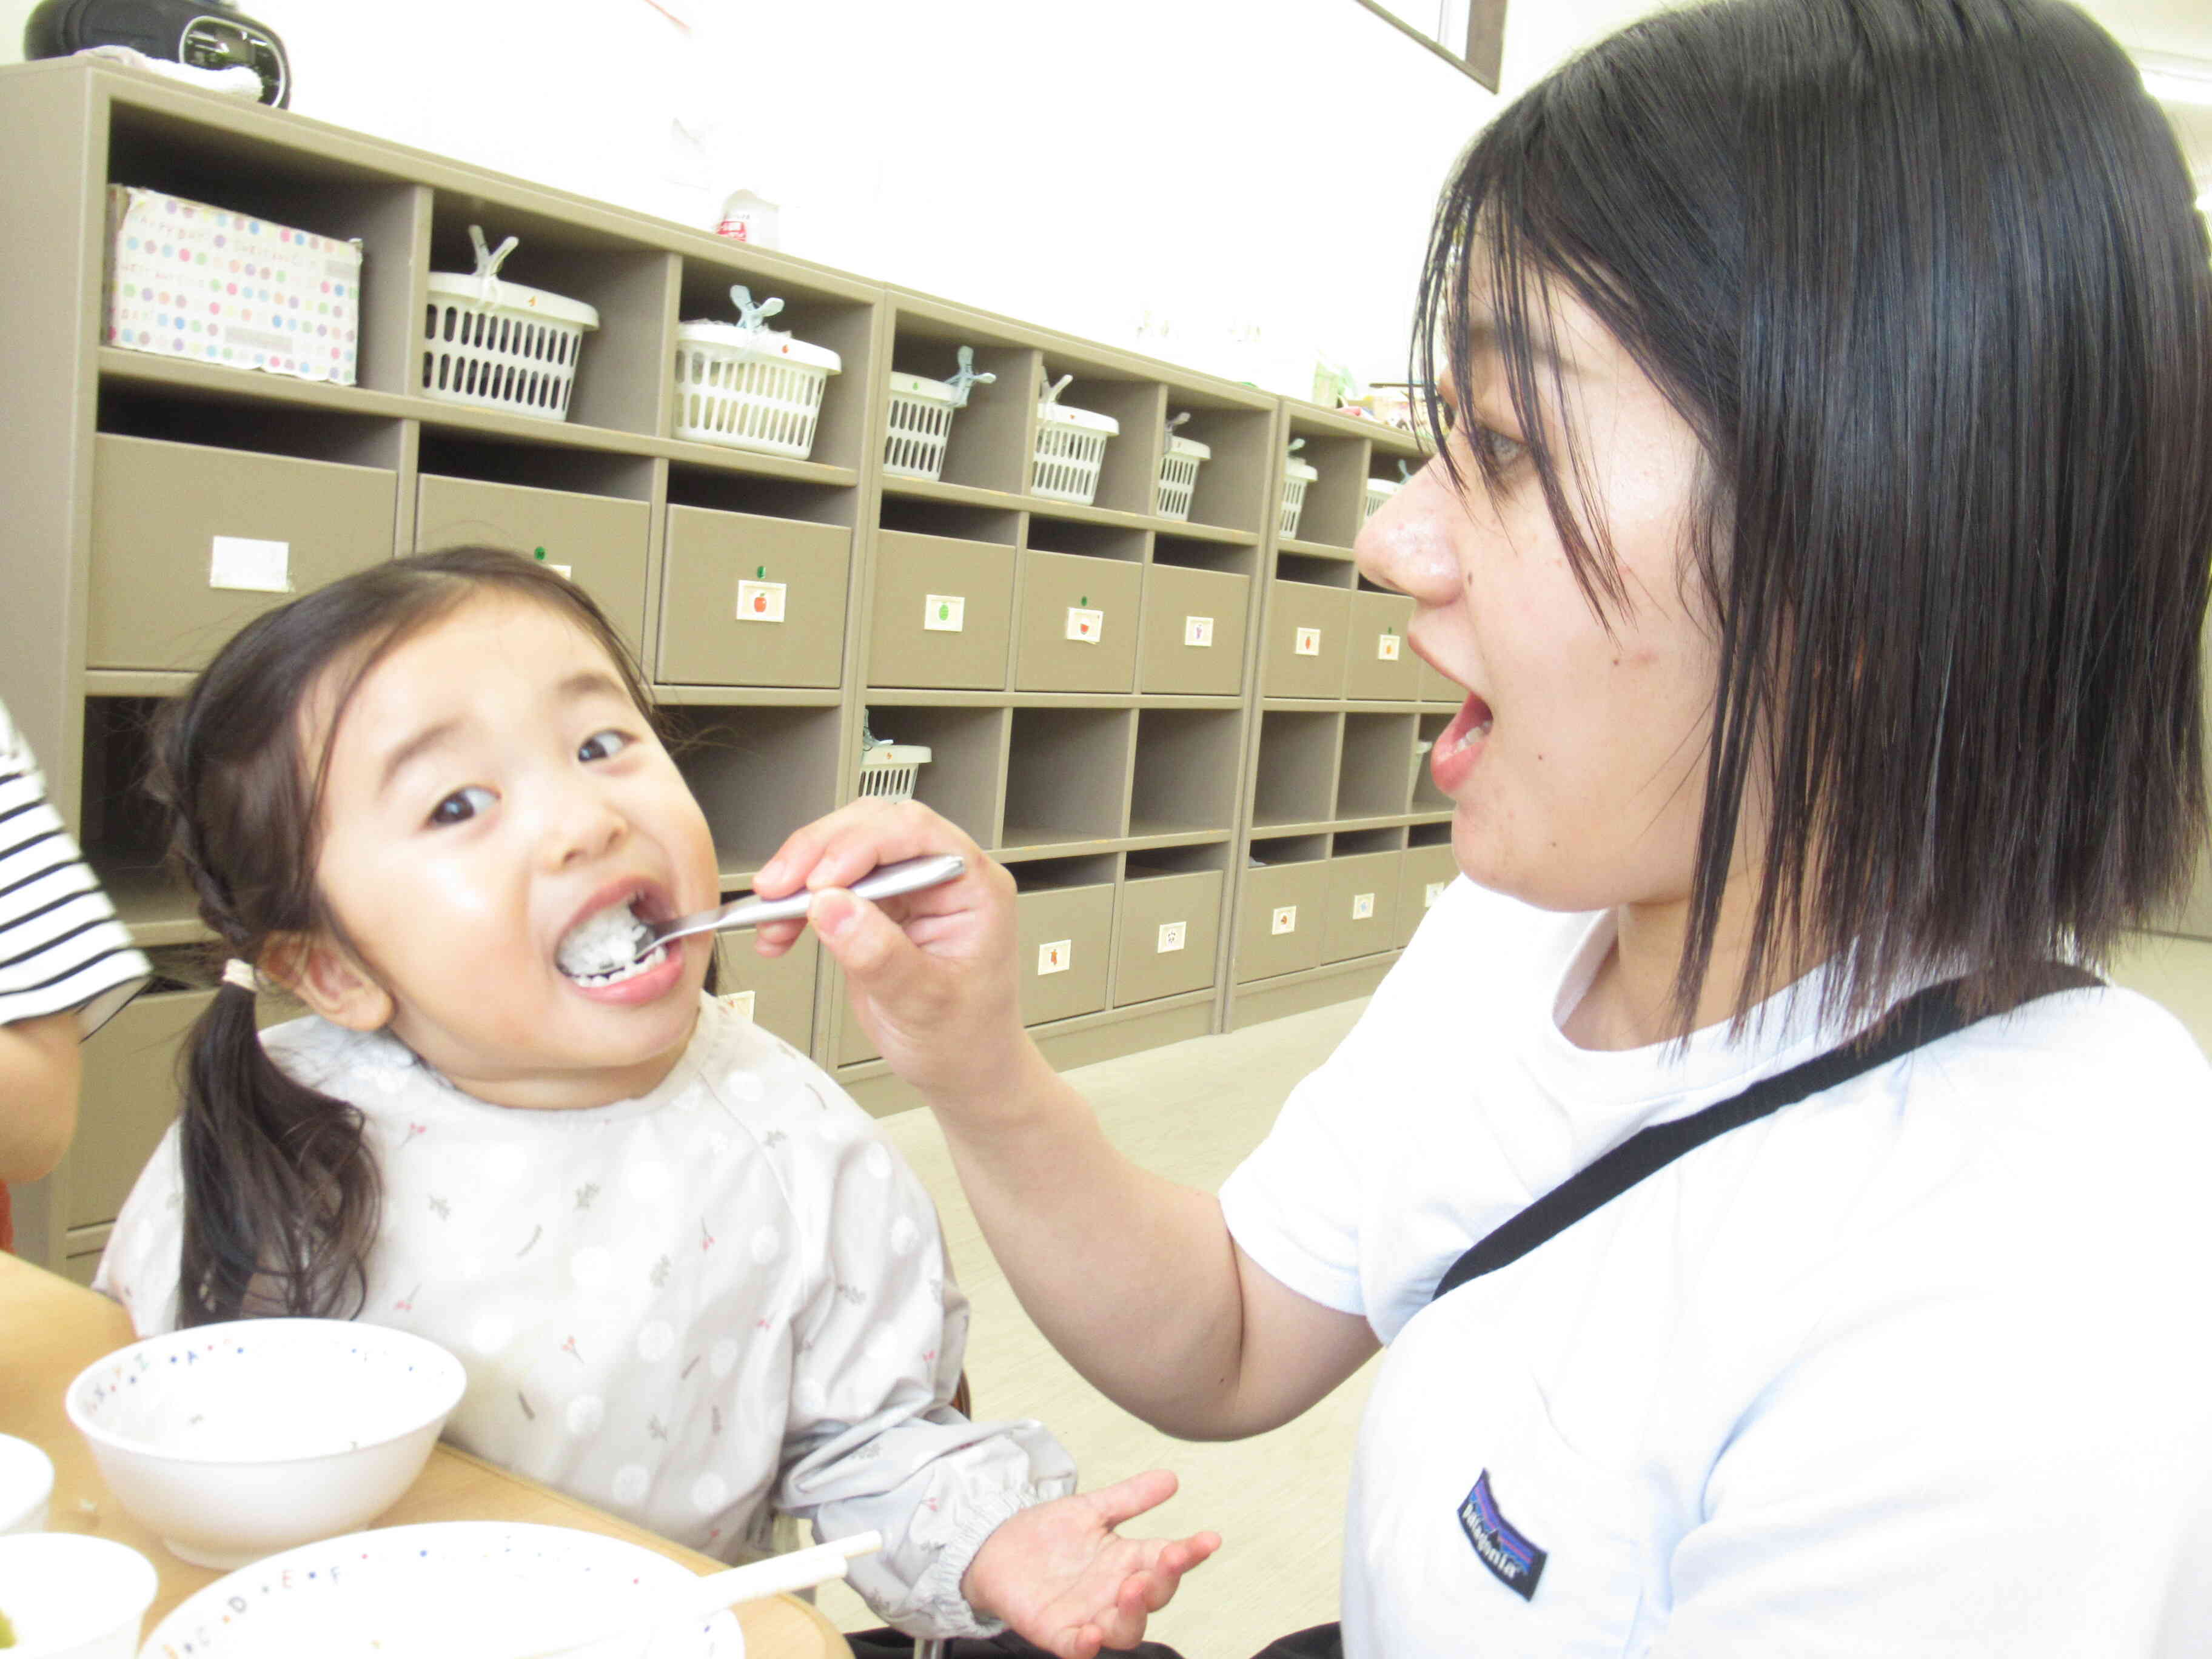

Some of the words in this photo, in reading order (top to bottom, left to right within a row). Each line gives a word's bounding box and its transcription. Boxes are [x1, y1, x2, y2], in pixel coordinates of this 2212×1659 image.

[227, 1595, 248, 1614] D
[281, 1568, 294, 1589] E
[330, 1566, 341, 1584] F
